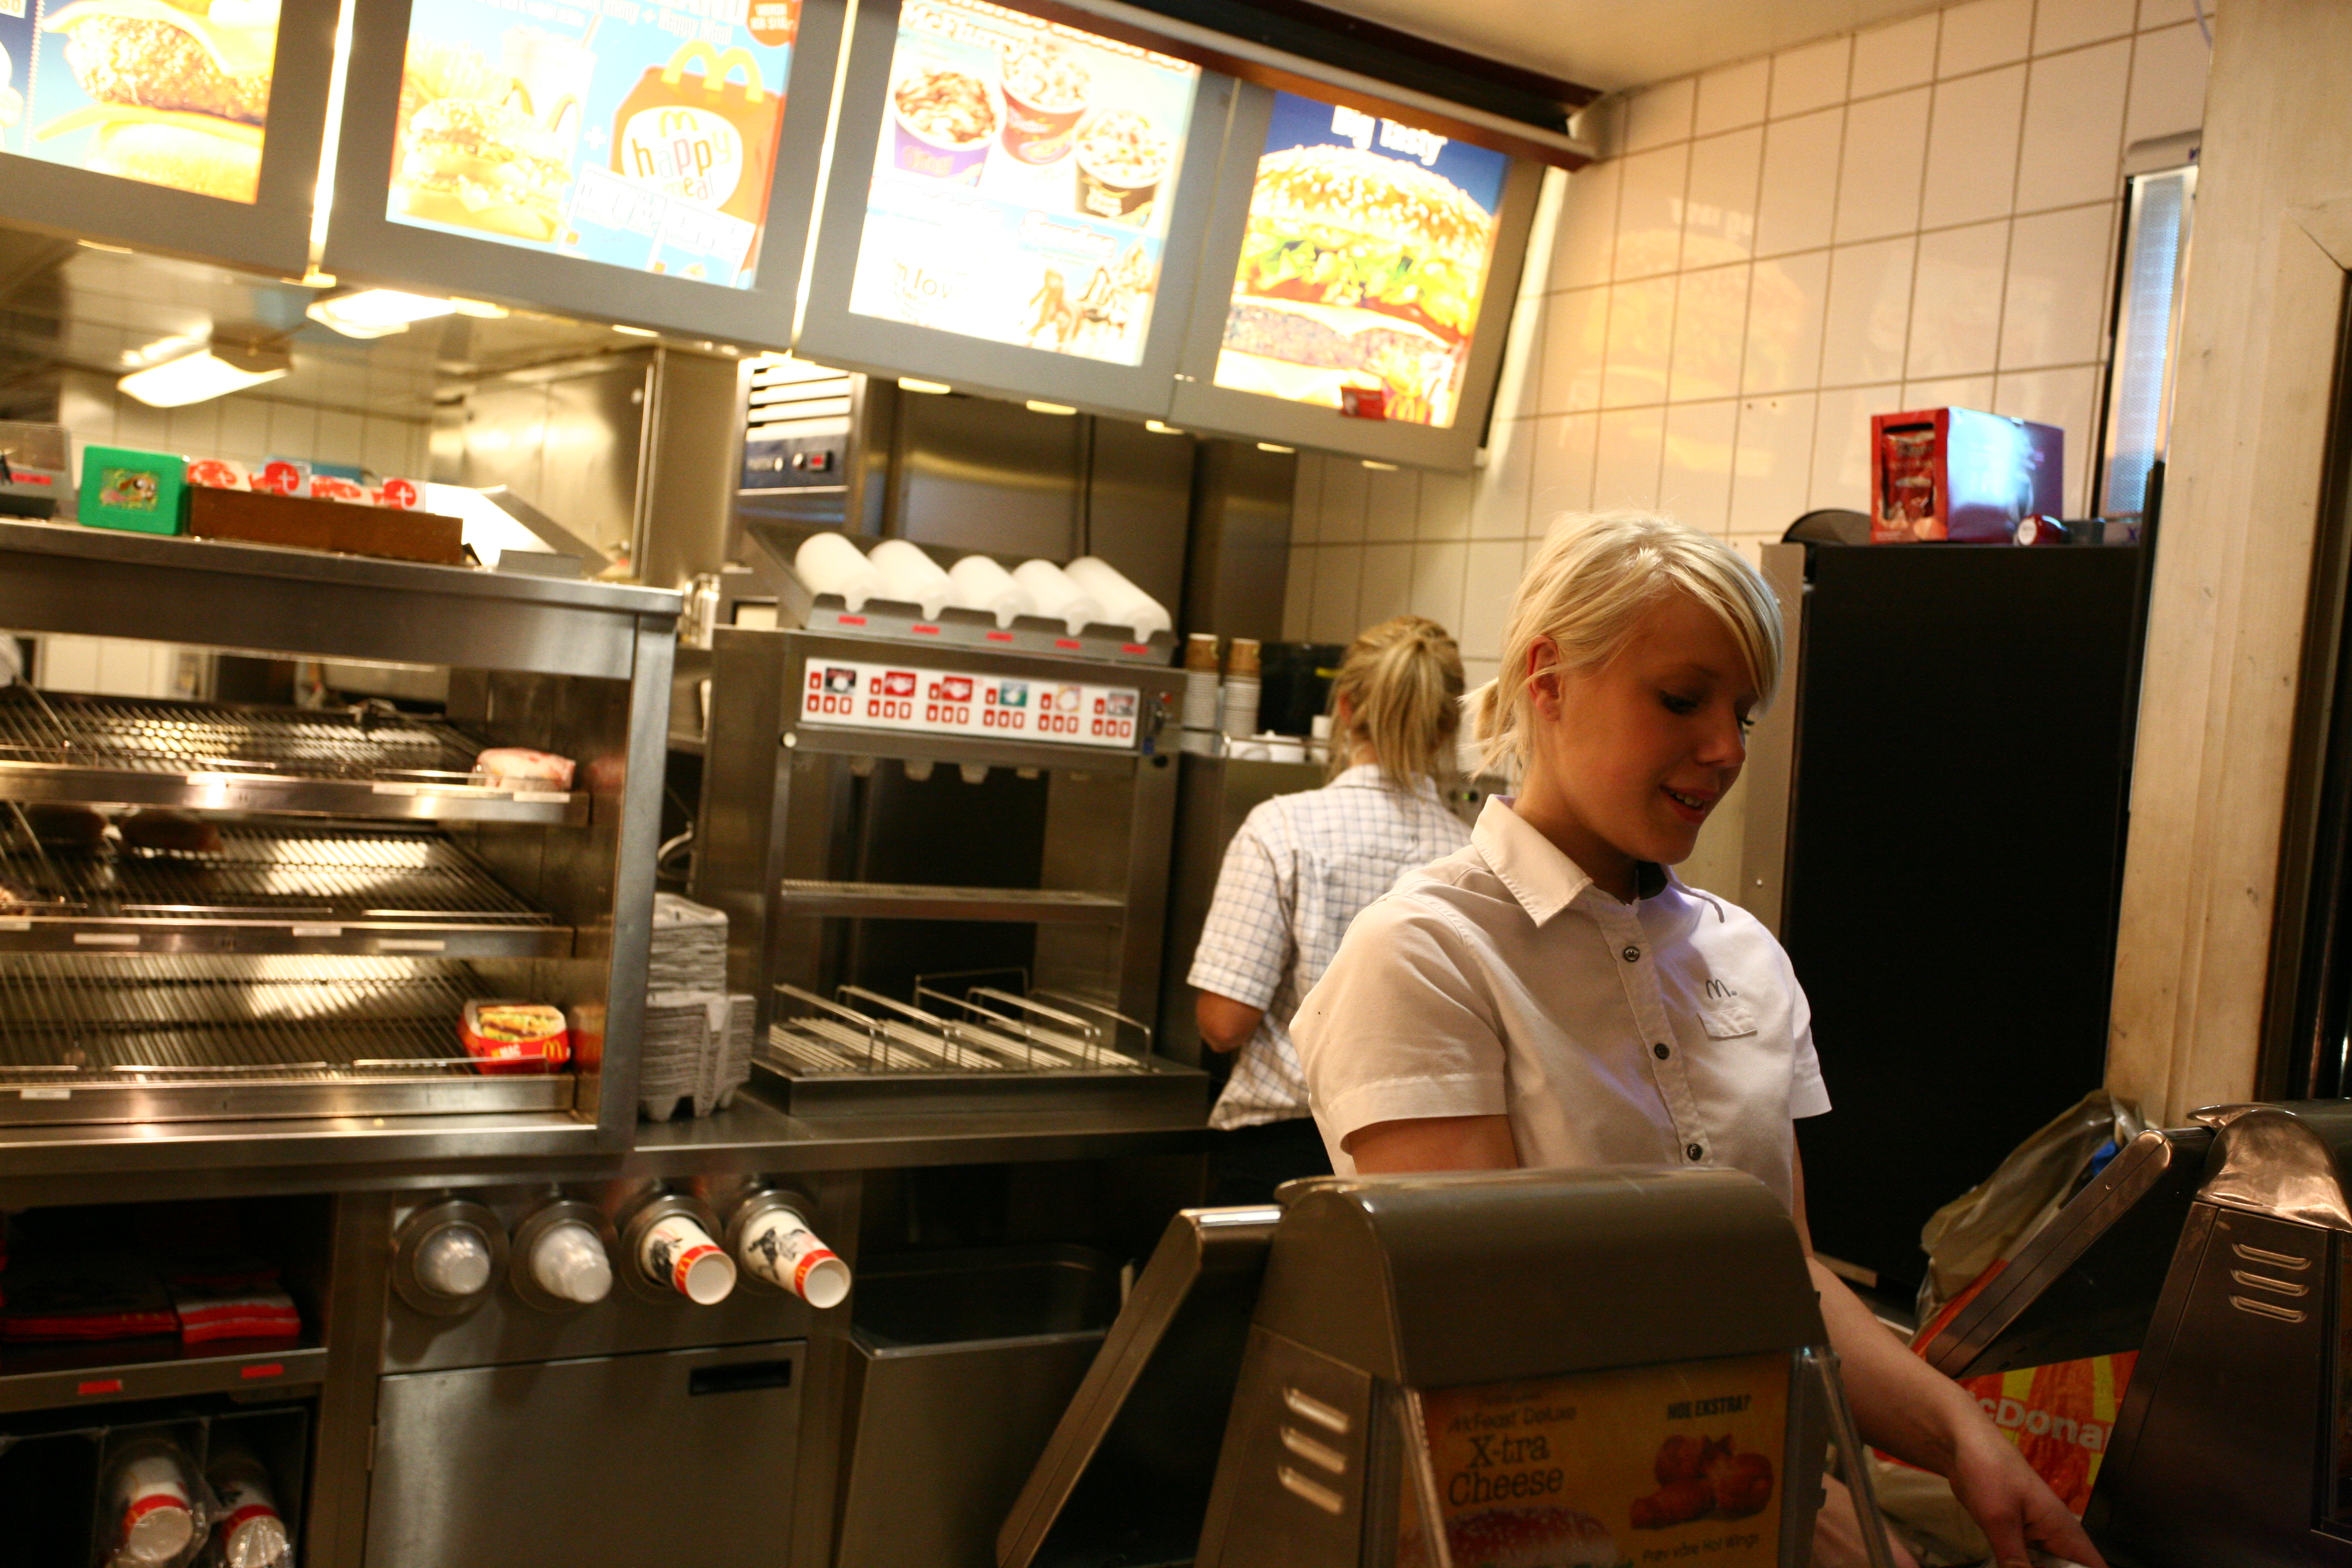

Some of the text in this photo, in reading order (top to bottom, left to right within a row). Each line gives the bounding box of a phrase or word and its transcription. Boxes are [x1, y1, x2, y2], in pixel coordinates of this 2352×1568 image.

[901, 1, 1028, 61] McFlurry
[631, 130, 732, 178] happy
[1380, 118, 1447, 166] Tasty
[663, 173, 715, 200] meal
[1019, 209, 1118, 260] Sundae
[1467, 1433, 1550, 1469] X-tra
[1448, 1467, 1564, 1506] Cheese
